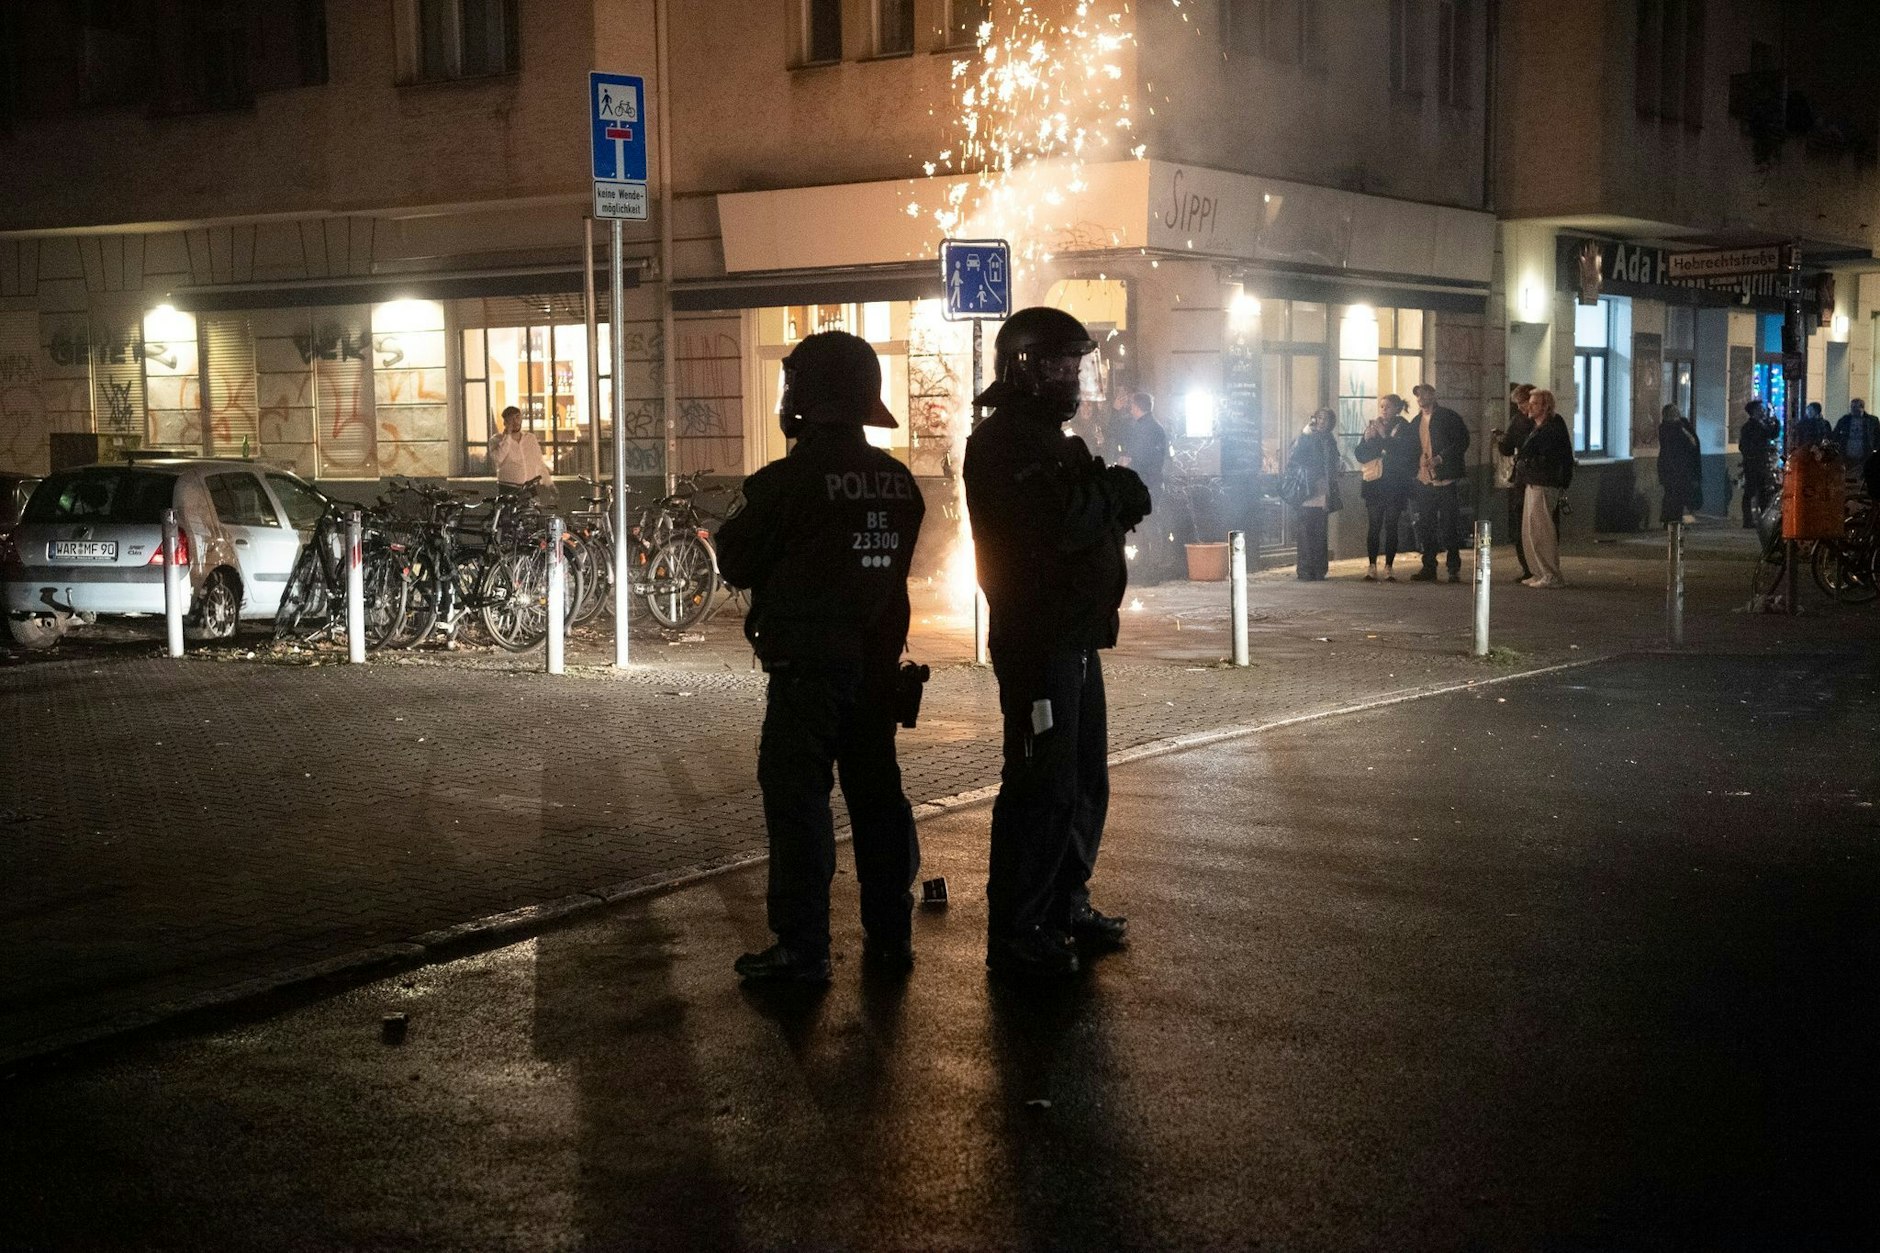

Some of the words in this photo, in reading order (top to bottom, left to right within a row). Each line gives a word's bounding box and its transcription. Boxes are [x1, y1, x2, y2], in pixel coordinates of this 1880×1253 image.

[597, 187, 616, 199] keine
[618, 189, 644, 200] Wende-
[602, 202, 641, 216] möglichkeit
[1612, 243, 1650, 283] Ada
[1674, 251, 1776, 271] Hobrechtstraße
[866, 511, 888, 529] BE
[56, 543, 77, 555] WAR
[83, 543, 98, 555] MF
[100, 543, 115, 555] 90
[852, 532, 899, 549] 23300
